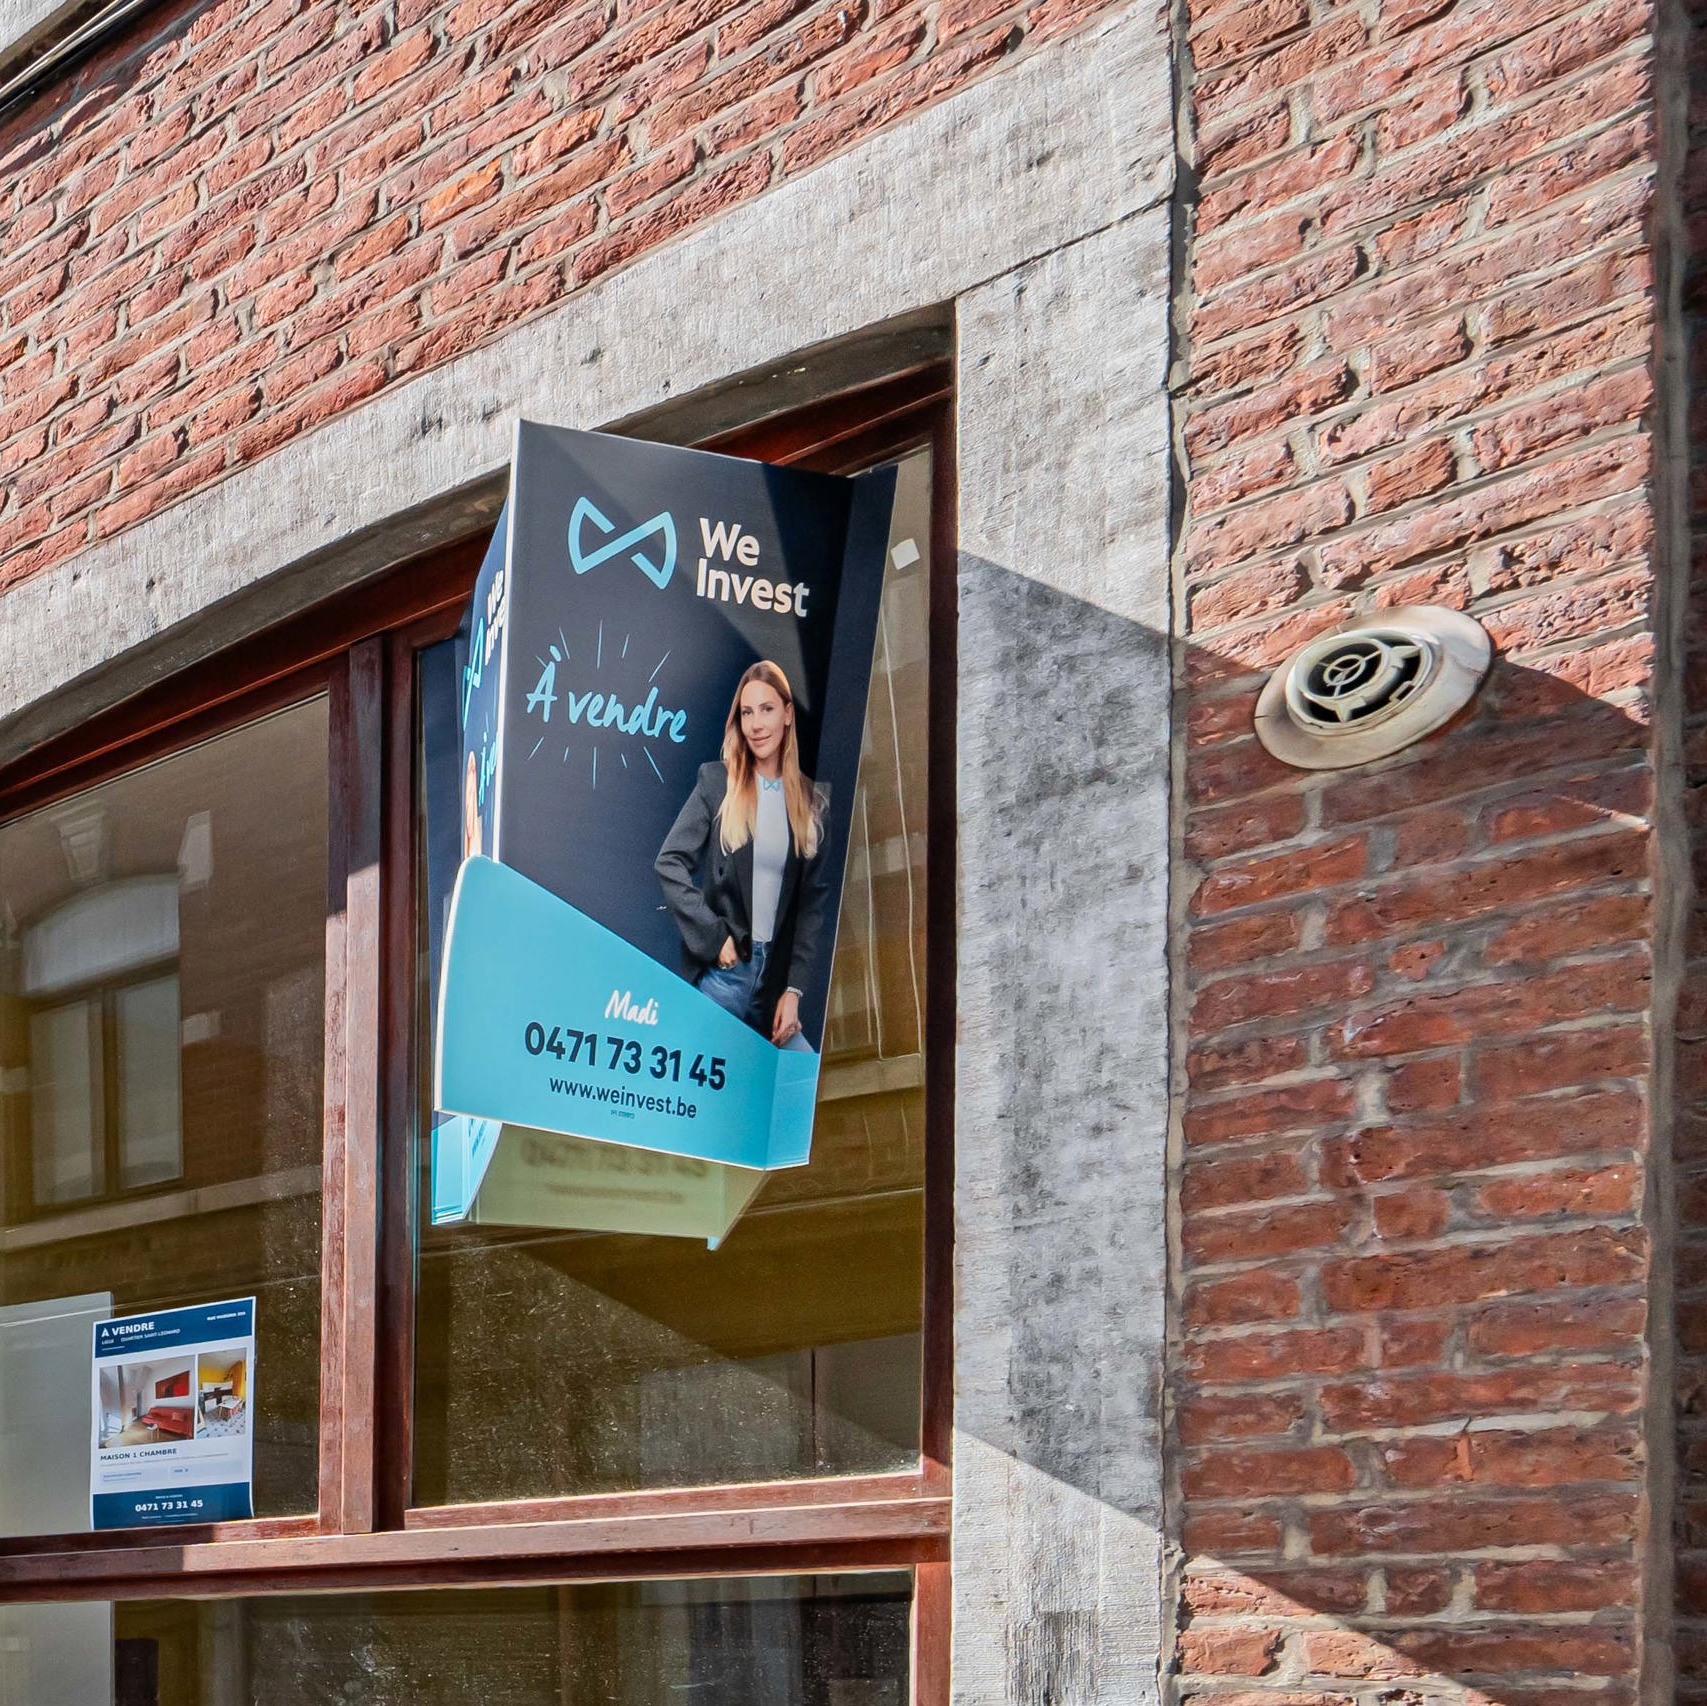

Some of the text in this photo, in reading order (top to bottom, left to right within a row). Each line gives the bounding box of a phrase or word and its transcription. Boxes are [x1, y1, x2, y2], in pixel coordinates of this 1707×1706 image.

[699, 516, 760, 567] We
[695, 557, 810, 618] Invest
[526, 644, 687, 745] À vendre
[604, 989, 660, 1026] Madi
[524, 1021, 726, 1091] 0471 73 31 45
[549, 1077, 697, 1118] www.weinvest.be
[112, 1321, 155, 1336] VENDRE
[100, 1453, 130, 1461] MAISON
[133, 1451, 137, 1459] 1
[139, 1448, 177, 1458] CHAMBRE
[134, 1499, 203, 1512] 0471 73 31 45
